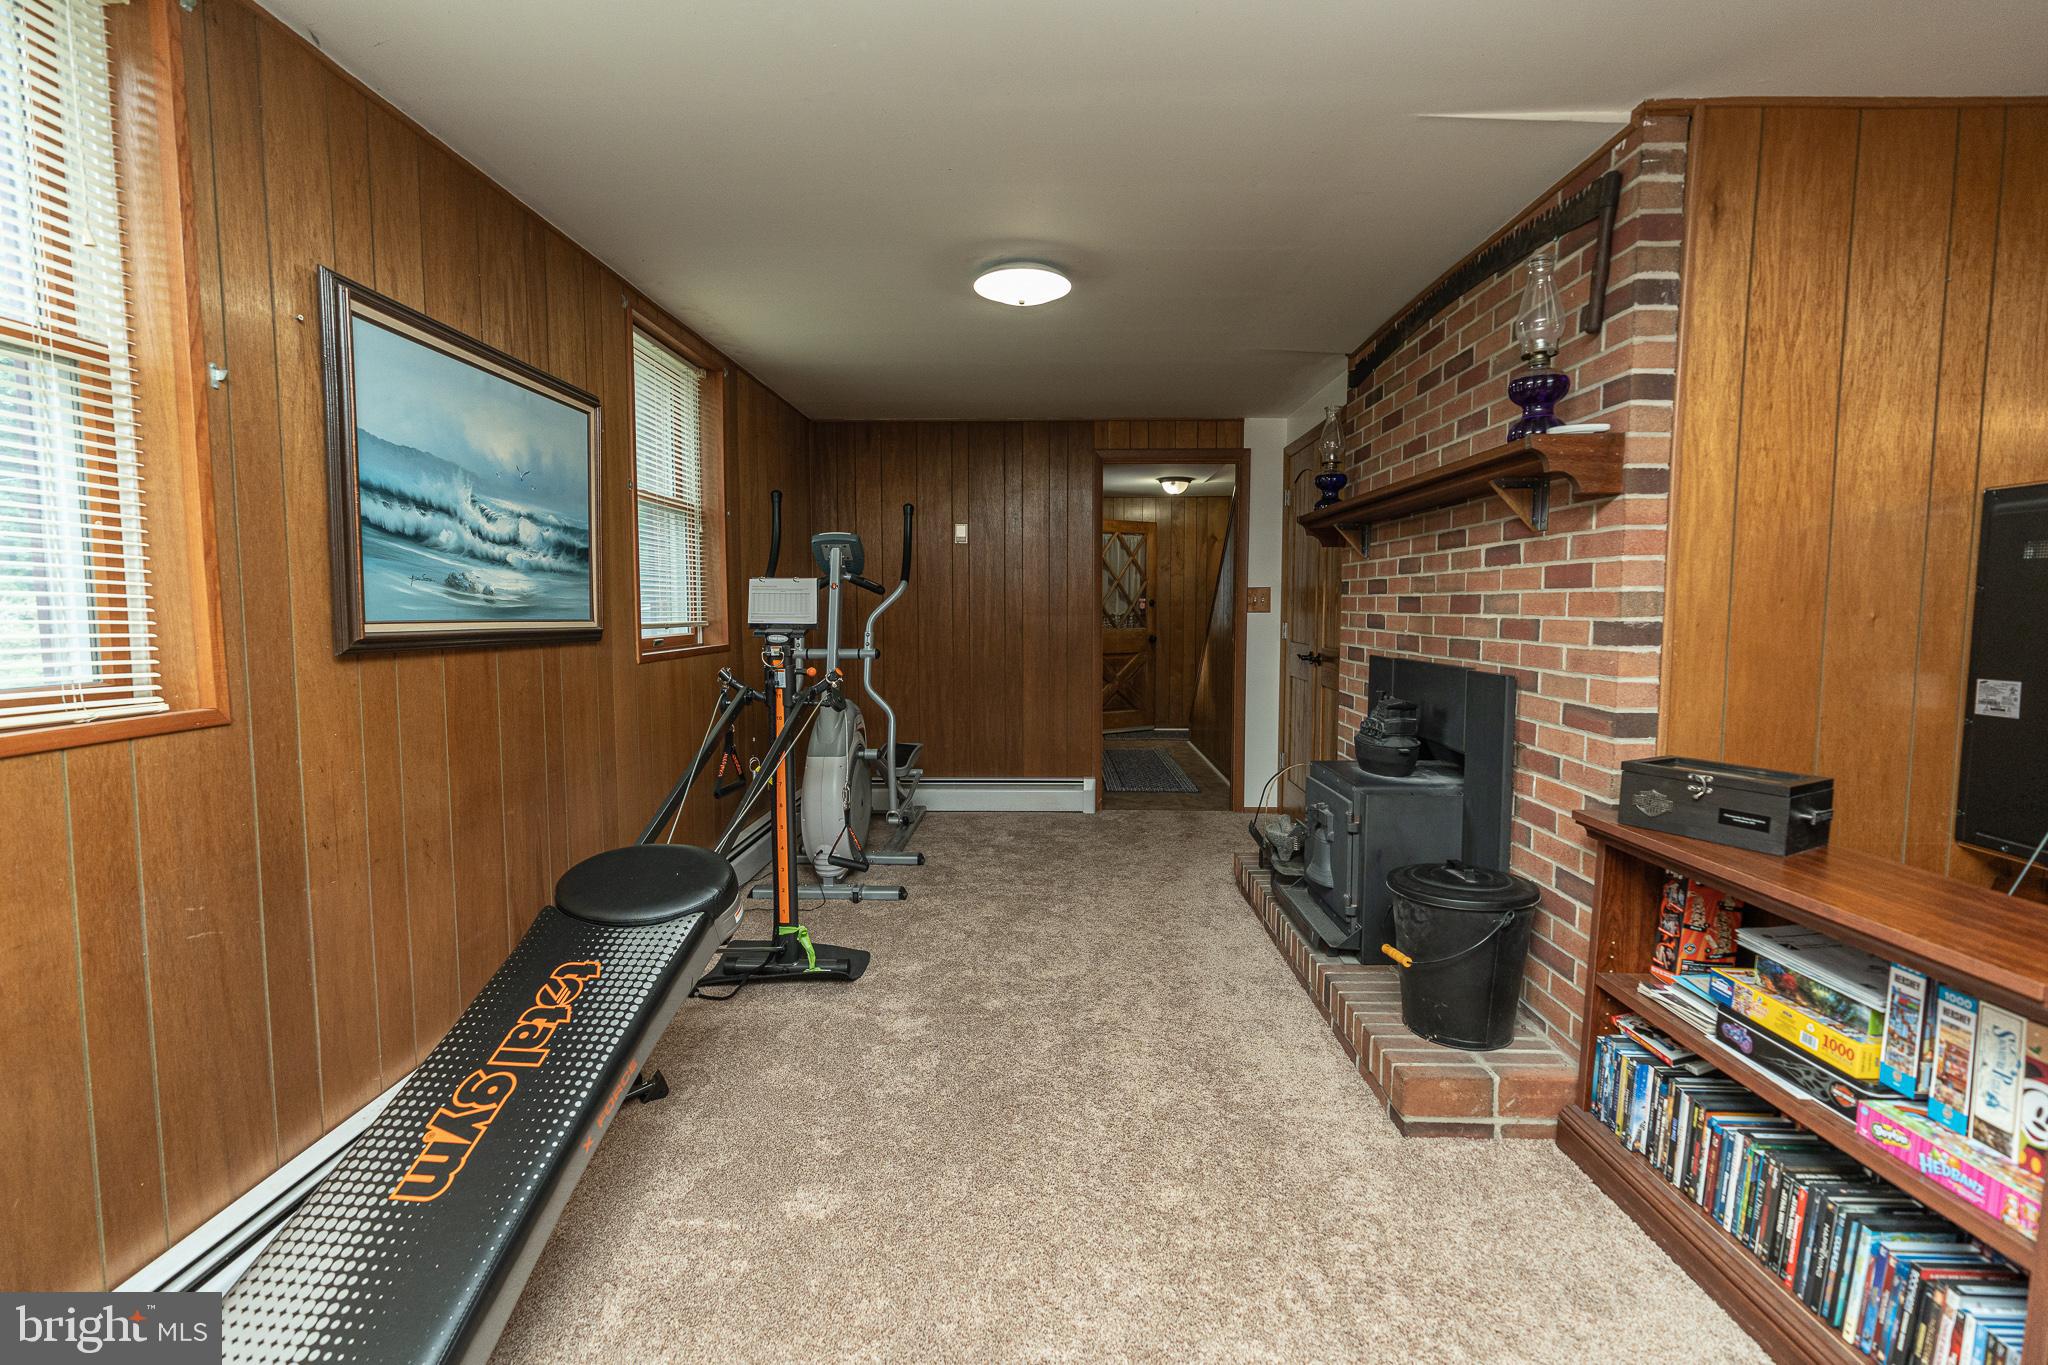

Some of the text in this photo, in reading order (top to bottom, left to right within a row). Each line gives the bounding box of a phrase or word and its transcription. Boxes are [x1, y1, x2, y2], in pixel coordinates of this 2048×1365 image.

[1894, 973, 1921, 991] HERSHEY
[1942, 1006, 1972, 1026] HERSHEY
[1944, 991, 1973, 1010] 1000
[1822, 1034, 1855, 1062] 1000
[388, 960, 603, 1202] total gym
[583, 1060, 637, 1153] X FORCE
[1918, 1152, 1985, 1197] HEDBANZ
[1815, 1222, 1831, 1278] HAPPENING
